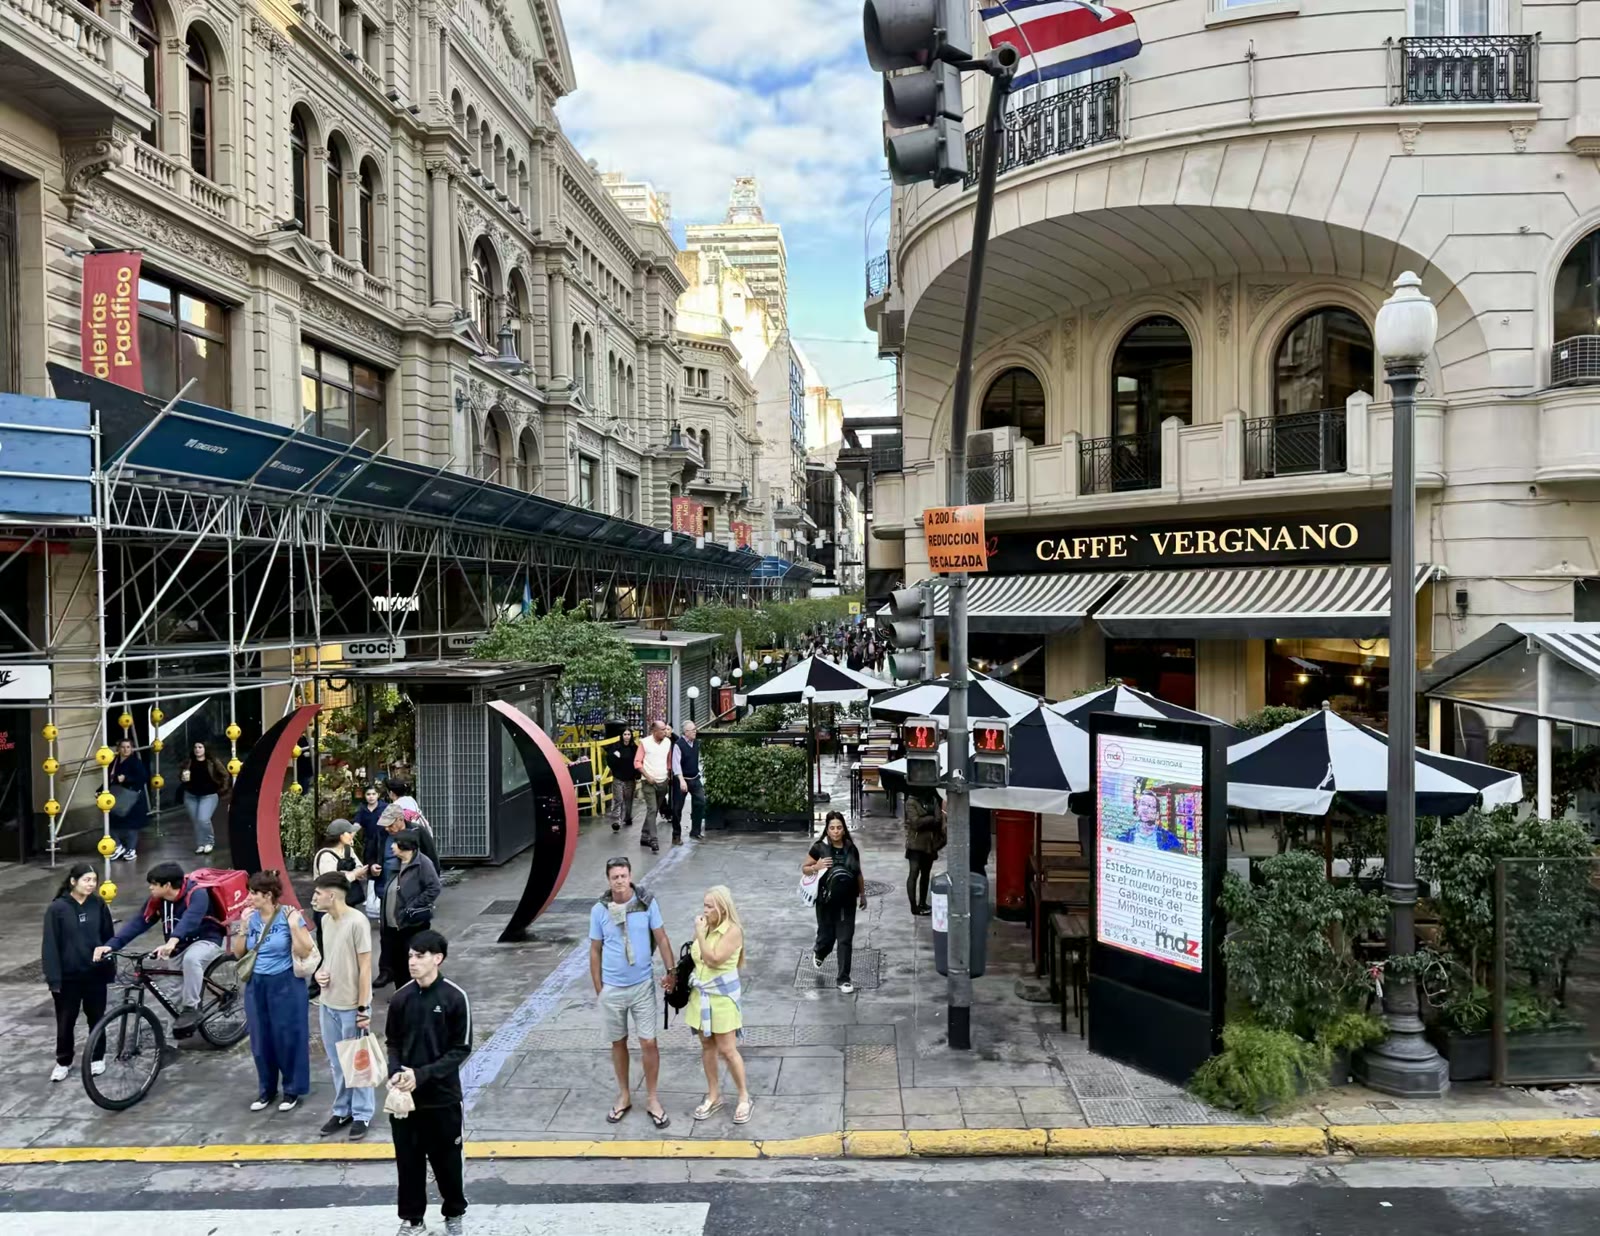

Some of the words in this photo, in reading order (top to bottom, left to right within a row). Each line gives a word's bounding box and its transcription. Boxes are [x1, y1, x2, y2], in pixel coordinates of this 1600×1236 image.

[110, 266, 133, 367] Pacífico
[928, 513, 934, 526] A
[935, 512, 950, 525] 200
[928, 532, 979, 547] REDUCCION
[1149, 522, 1359, 556] VERGNANO
[930, 556, 939, 568] DE
[939, 554, 984, 568] CALZADA
[348, 643, 396, 655] crocs
[1105, 859, 1144, 878] Esteban
[1146, 868, 1198, 891] Mahiques
[1105, 873, 1116, 882] es
[1117, 875, 1127, 886] el
[1129, 879, 1160, 894] nuevo
[1161, 885, 1182, 899] jefe
[1184, 891, 1199, 904] de
[1118, 888, 1164, 908] Gabinete
[1166, 900, 1183, 913] del
[1117, 899, 1169, 922] Ministerio
[1170, 913, 1184, 926] de
[1131, 916, 1168, 934] Justicia
[1155, 931, 1199, 958] mdz
